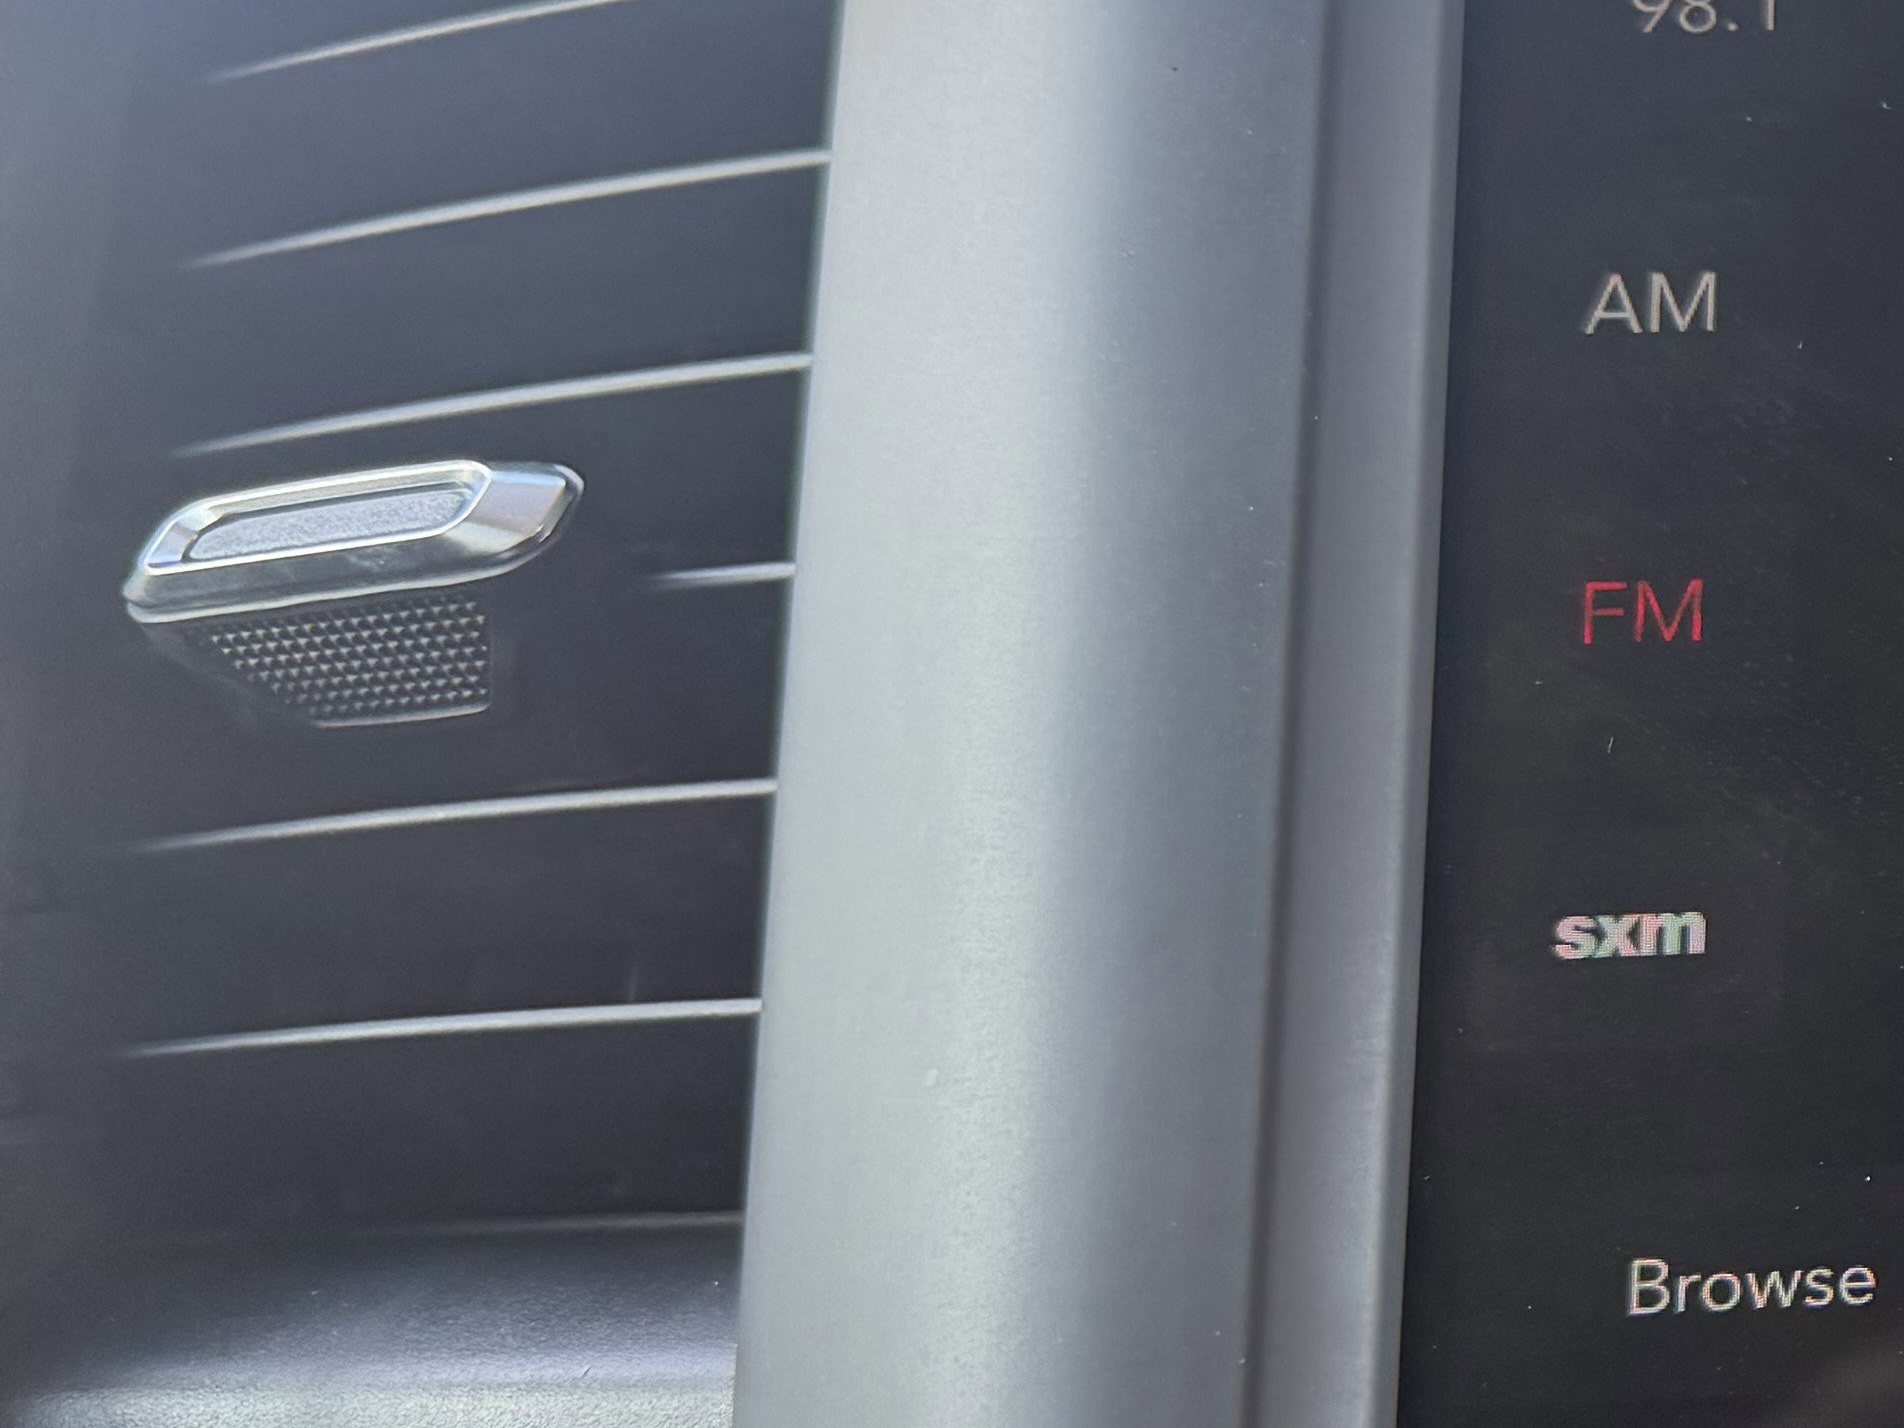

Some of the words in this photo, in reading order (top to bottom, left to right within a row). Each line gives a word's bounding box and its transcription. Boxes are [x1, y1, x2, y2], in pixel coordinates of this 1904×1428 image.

[1584, 271, 1716, 335] AM
[1583, 579, 1704, 645] FM
[1554, 911, 1706, 960] sxm
[1628, 1258, 1877, 1316] Browse
